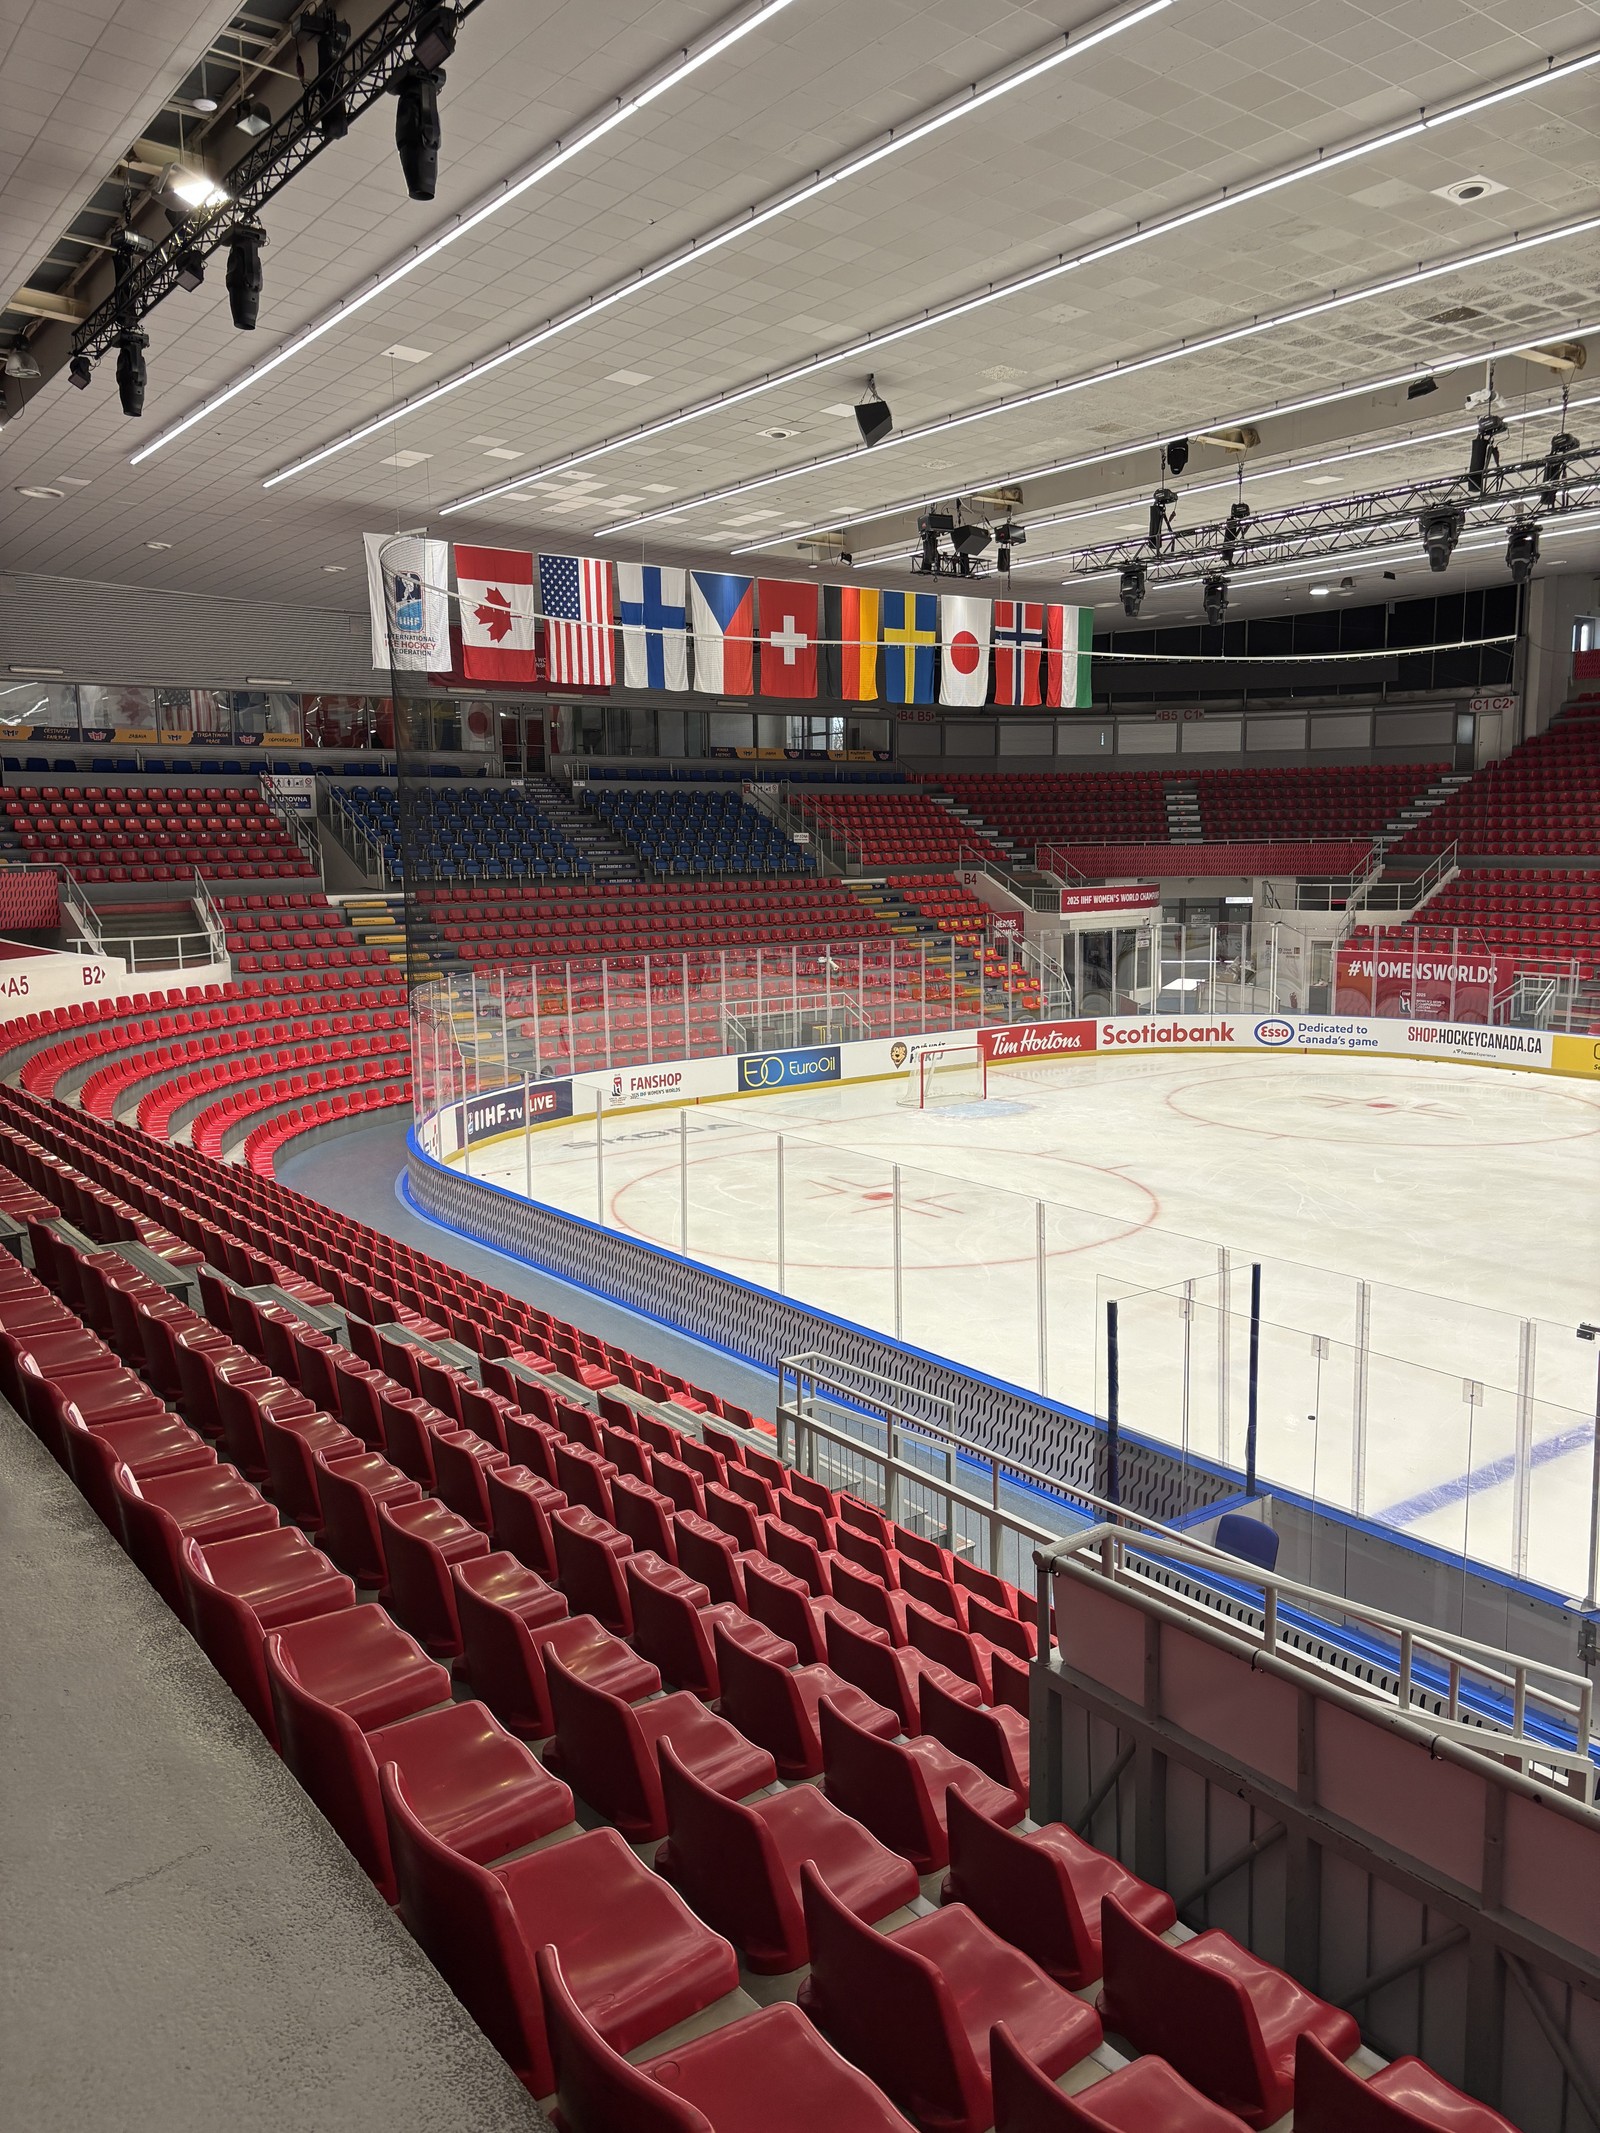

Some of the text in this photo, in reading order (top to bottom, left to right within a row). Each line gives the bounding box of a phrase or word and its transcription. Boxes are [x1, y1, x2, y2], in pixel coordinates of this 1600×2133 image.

[400, 641, 436, 650] HOCKEY
[1473, 698, 1510, 710] C1 C2
[900, 710, 931, 721] B4 B5
[1161, 709, 1199, 720] B5 C1
[963, 873, 977, 885] B4
[1066, 896, 1079, 905] 2025
[1080, 895, 1092, 904] IIHF
[1093, 894, 1119, 904] WOMEN'S
[1120, 893, 1139, 902] WORLD
[82, 966, 101, 986] B2
[1348, 960, 1498, 984] #WOMENSWORLDS
[8, 975, 29, 998] A5
[1102, 1021, 1235, 1045] Scotiabank
[1260, 1026, 1289, 1038] Esso
[1298, 1023, 1368, 1034] Dedicated to
[991, 1028, 1081, 1056] Tim Hortons
[1298, 1034, 1378, 1048] Canada's game
[1407, 1026, 1542, 1054] SHOP.HOCKEYCANADA.CA
[789, 1056, 835, 1076] EuroOil
[630, 1072, 682, 1091] FANSHOP
[529, 1095, 554, 1113] LIVE
[474, 1103, 523, 1131] IIHF.TV
